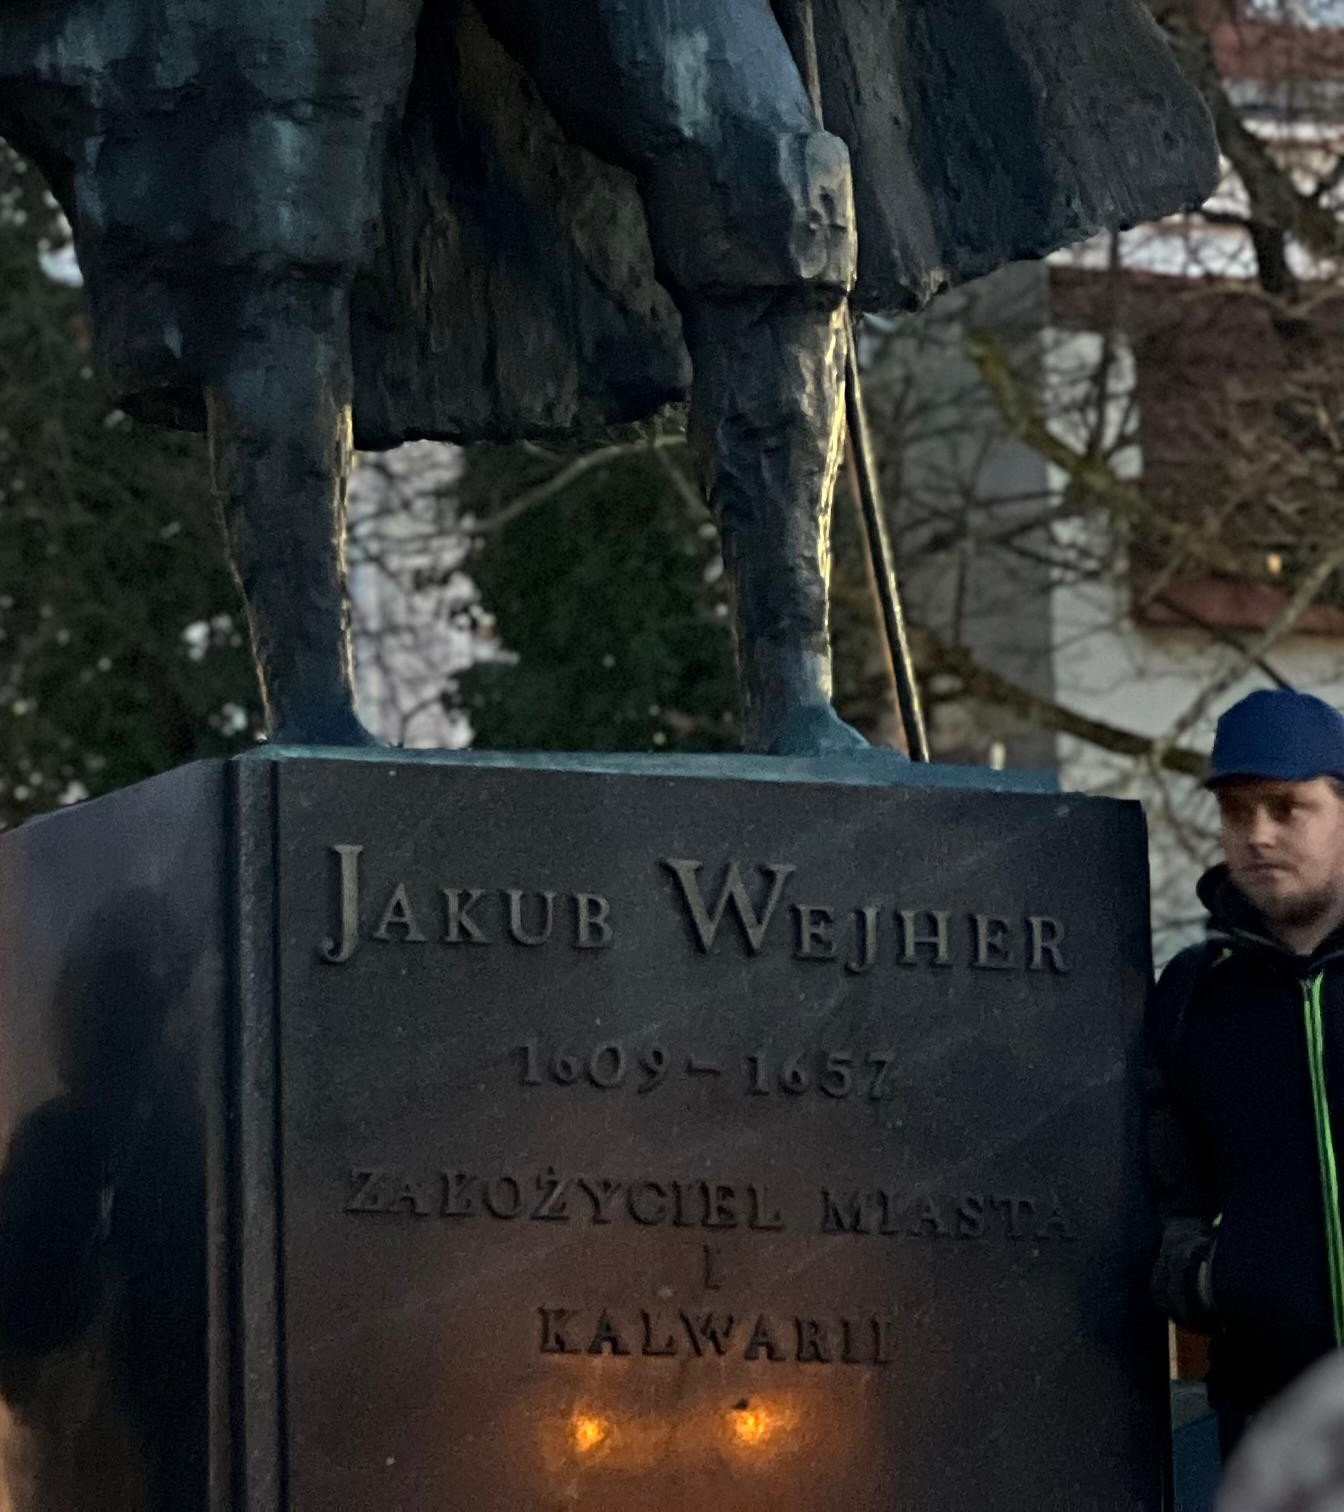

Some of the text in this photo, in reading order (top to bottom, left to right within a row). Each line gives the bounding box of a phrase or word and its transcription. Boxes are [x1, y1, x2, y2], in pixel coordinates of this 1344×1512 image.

[320, 844, 1069, 974] JAKUB WEJHER
[343, 1165, 1079, 1244] ZAŁOŻYCIEL MIASTA
[537, 1305, 894, 1366] KALWARII
